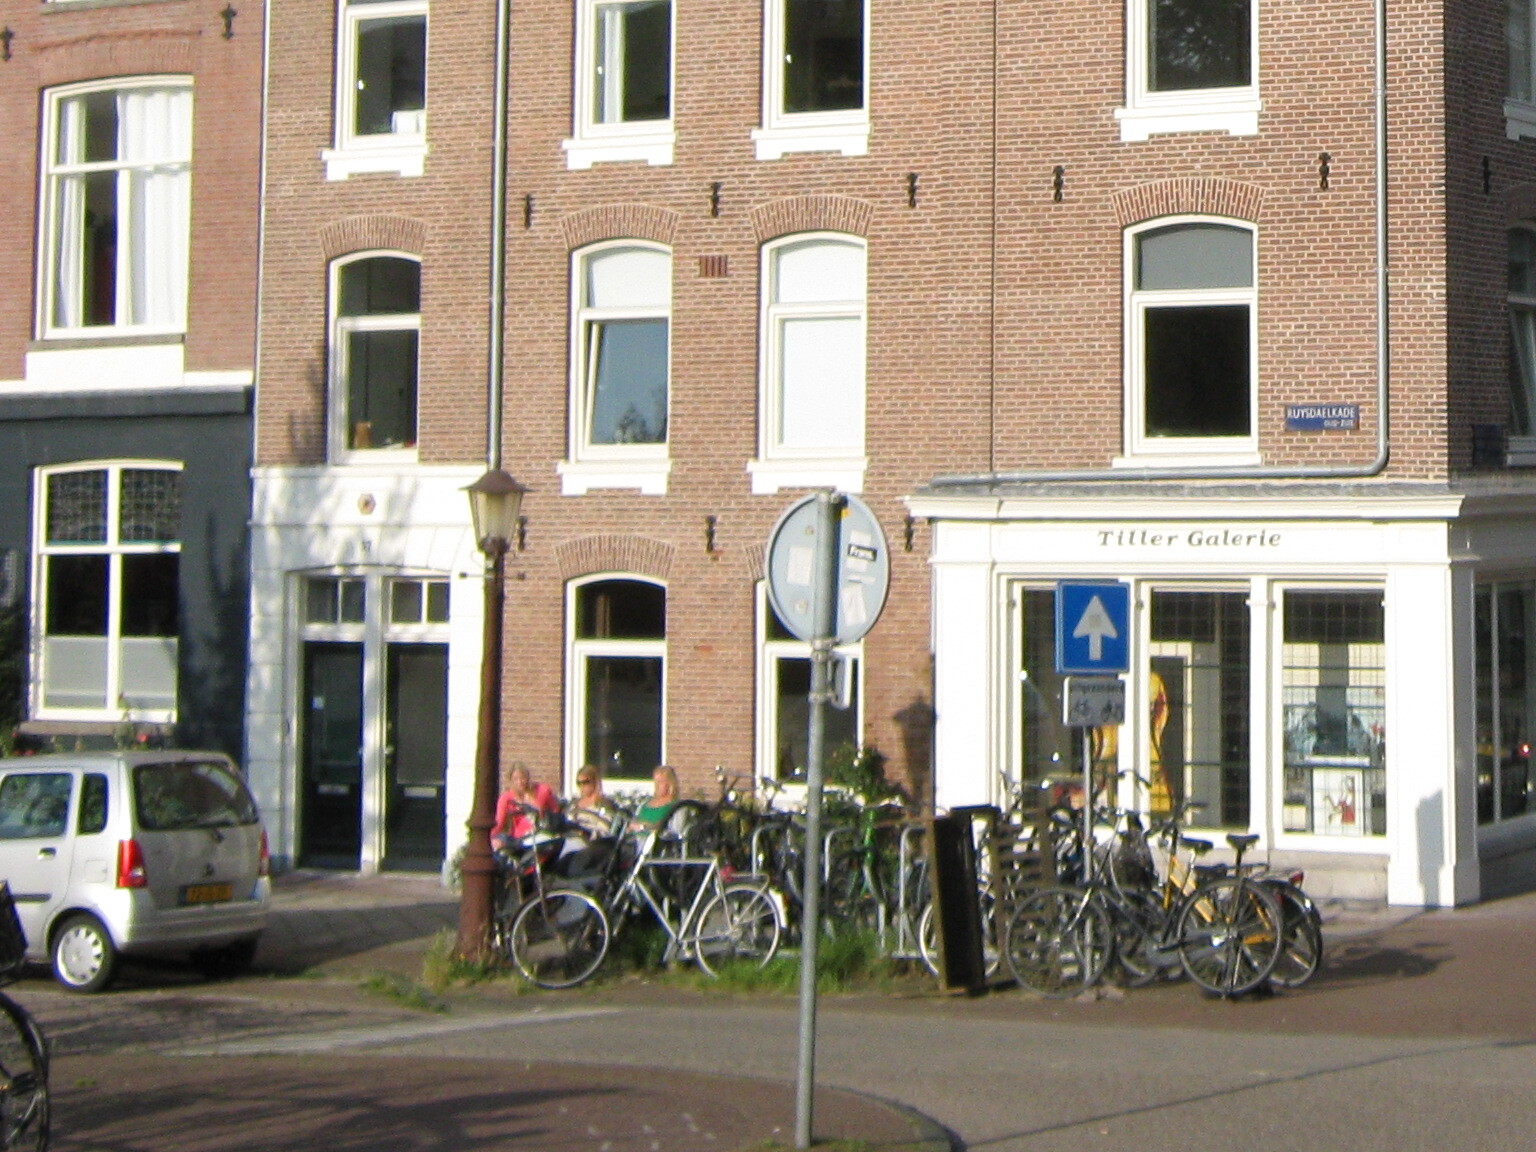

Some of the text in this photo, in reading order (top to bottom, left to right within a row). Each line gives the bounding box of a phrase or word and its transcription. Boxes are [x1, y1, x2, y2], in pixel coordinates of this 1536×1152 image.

[1287, 407, 1355, 419] RUYSDAELKADE
[1098, 529, 1282, 547] Tiller Galerie
